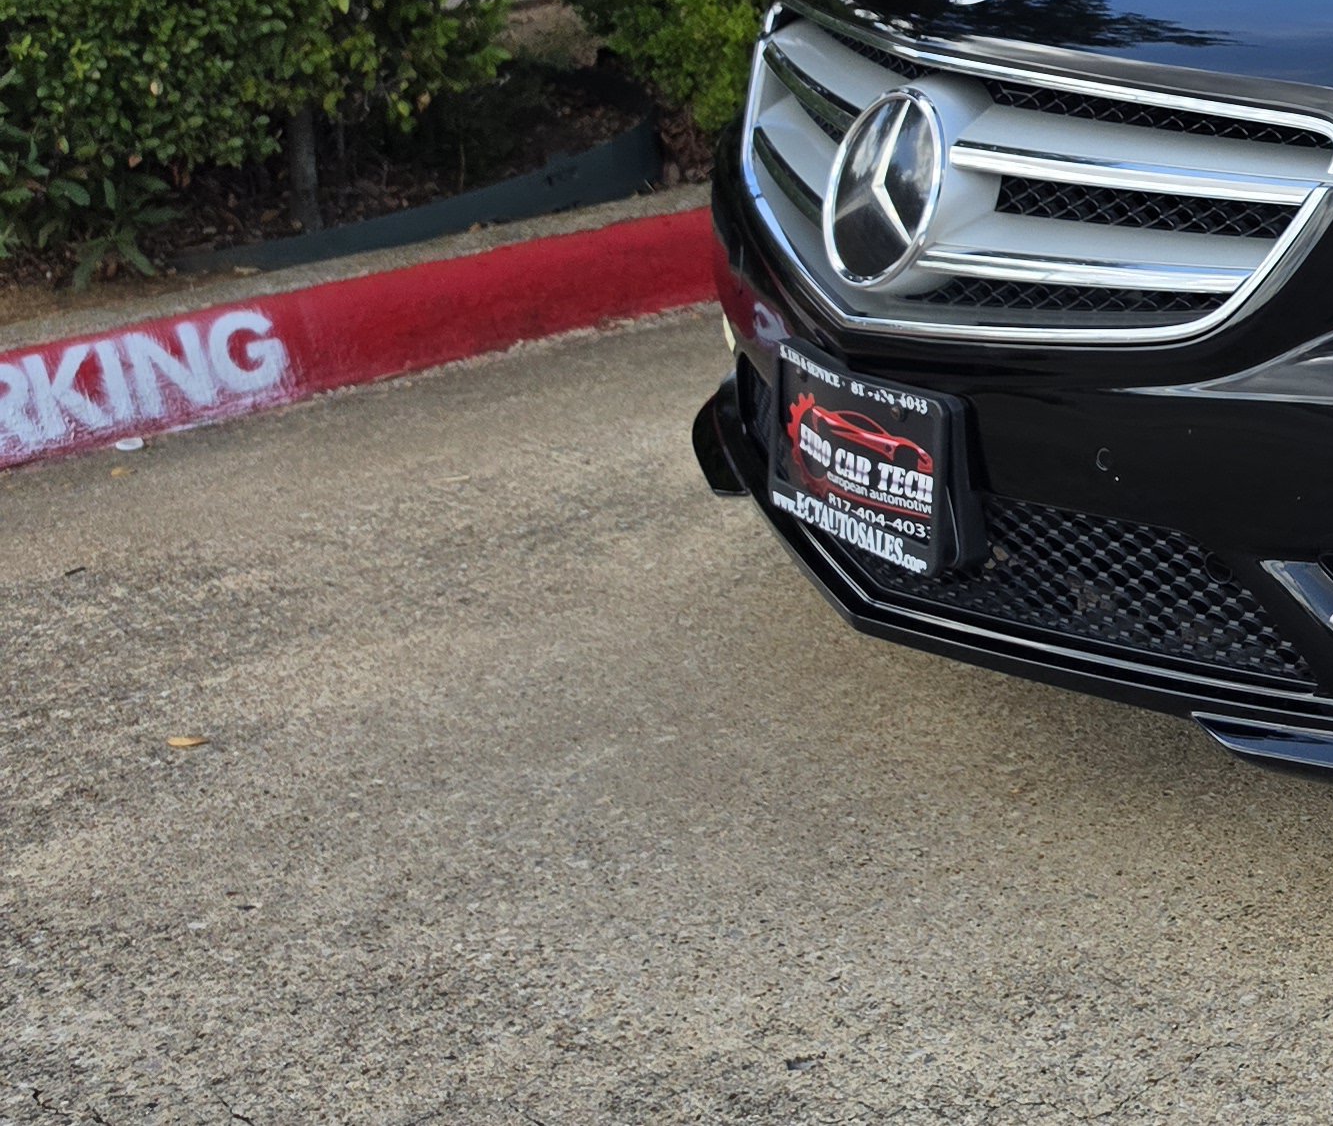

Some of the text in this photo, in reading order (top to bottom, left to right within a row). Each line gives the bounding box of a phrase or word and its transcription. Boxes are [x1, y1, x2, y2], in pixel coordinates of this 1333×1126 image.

[800, 423, 934, 503] EURO CAR TECH
[826, 471, 932, 514] european automotiv
